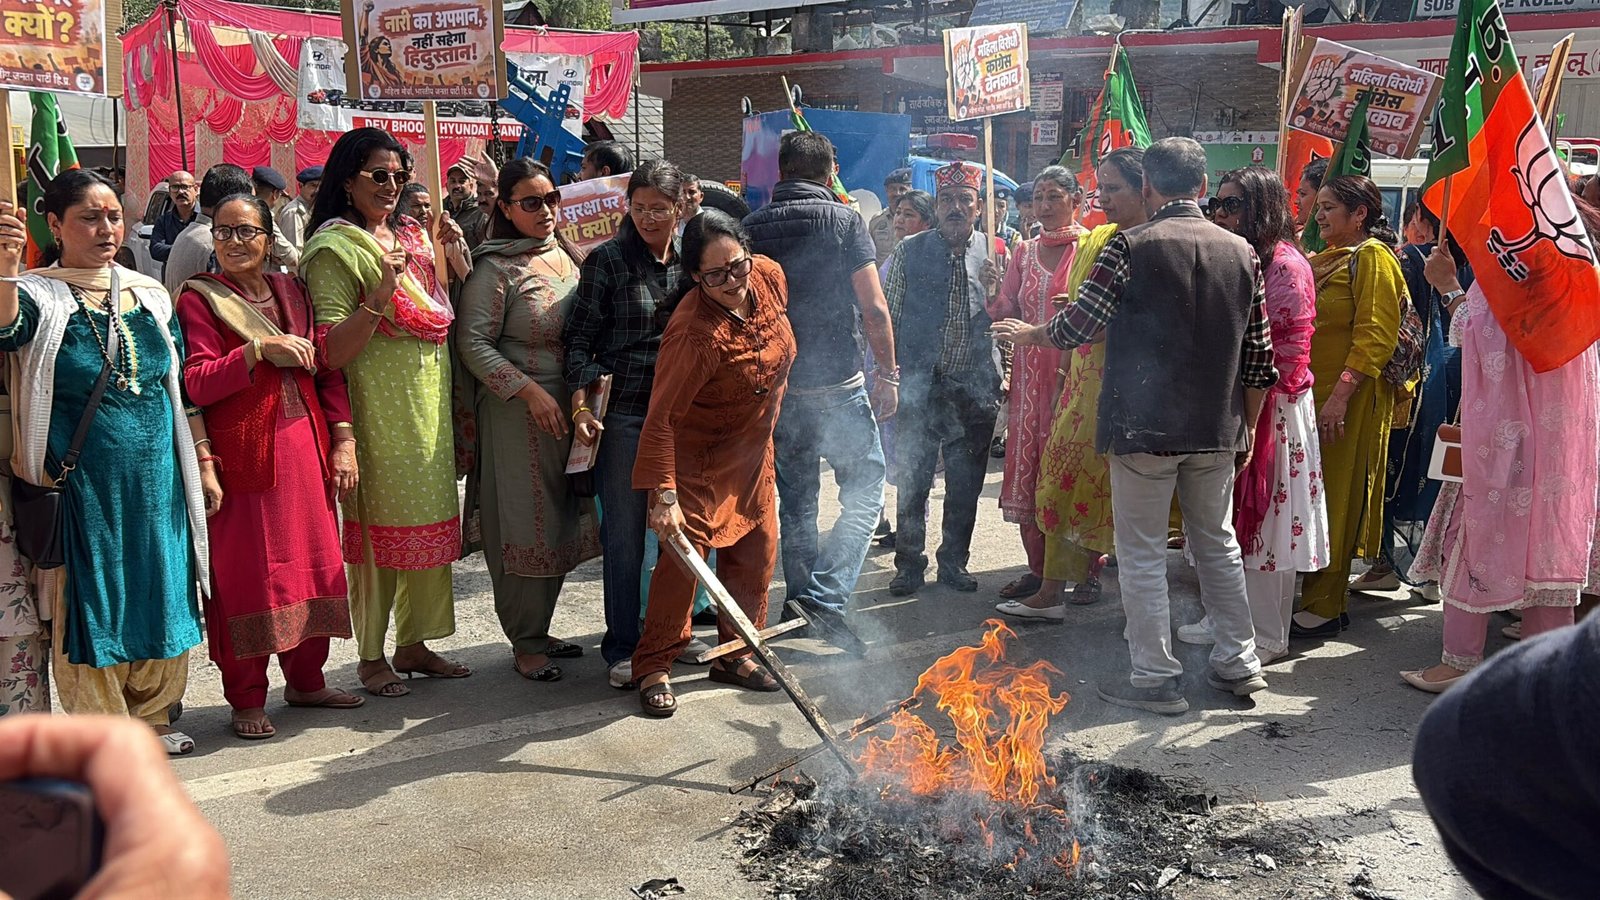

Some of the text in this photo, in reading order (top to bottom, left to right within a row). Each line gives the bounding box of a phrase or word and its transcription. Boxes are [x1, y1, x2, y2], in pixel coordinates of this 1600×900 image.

[1424, 0, 1454, 11] SUB
[3, 3, 75, 43] क्यों?
[384, 8, 483, 33] नारी का अपमान,
[411, 31, 466, 49] नहीं सहेगा
[1349, 67, 1425, 94] महिला विरोधी
[365, 119, 388, 128] DEV
[392, 120, 426, 133] BHOO
[440, 122, 489, 136] HYUNDAI
[563, 199, 601, 222] सुरक्षा
[602, 196, 620, 209] पर
[581, 211, 623, 239] क्यों?
